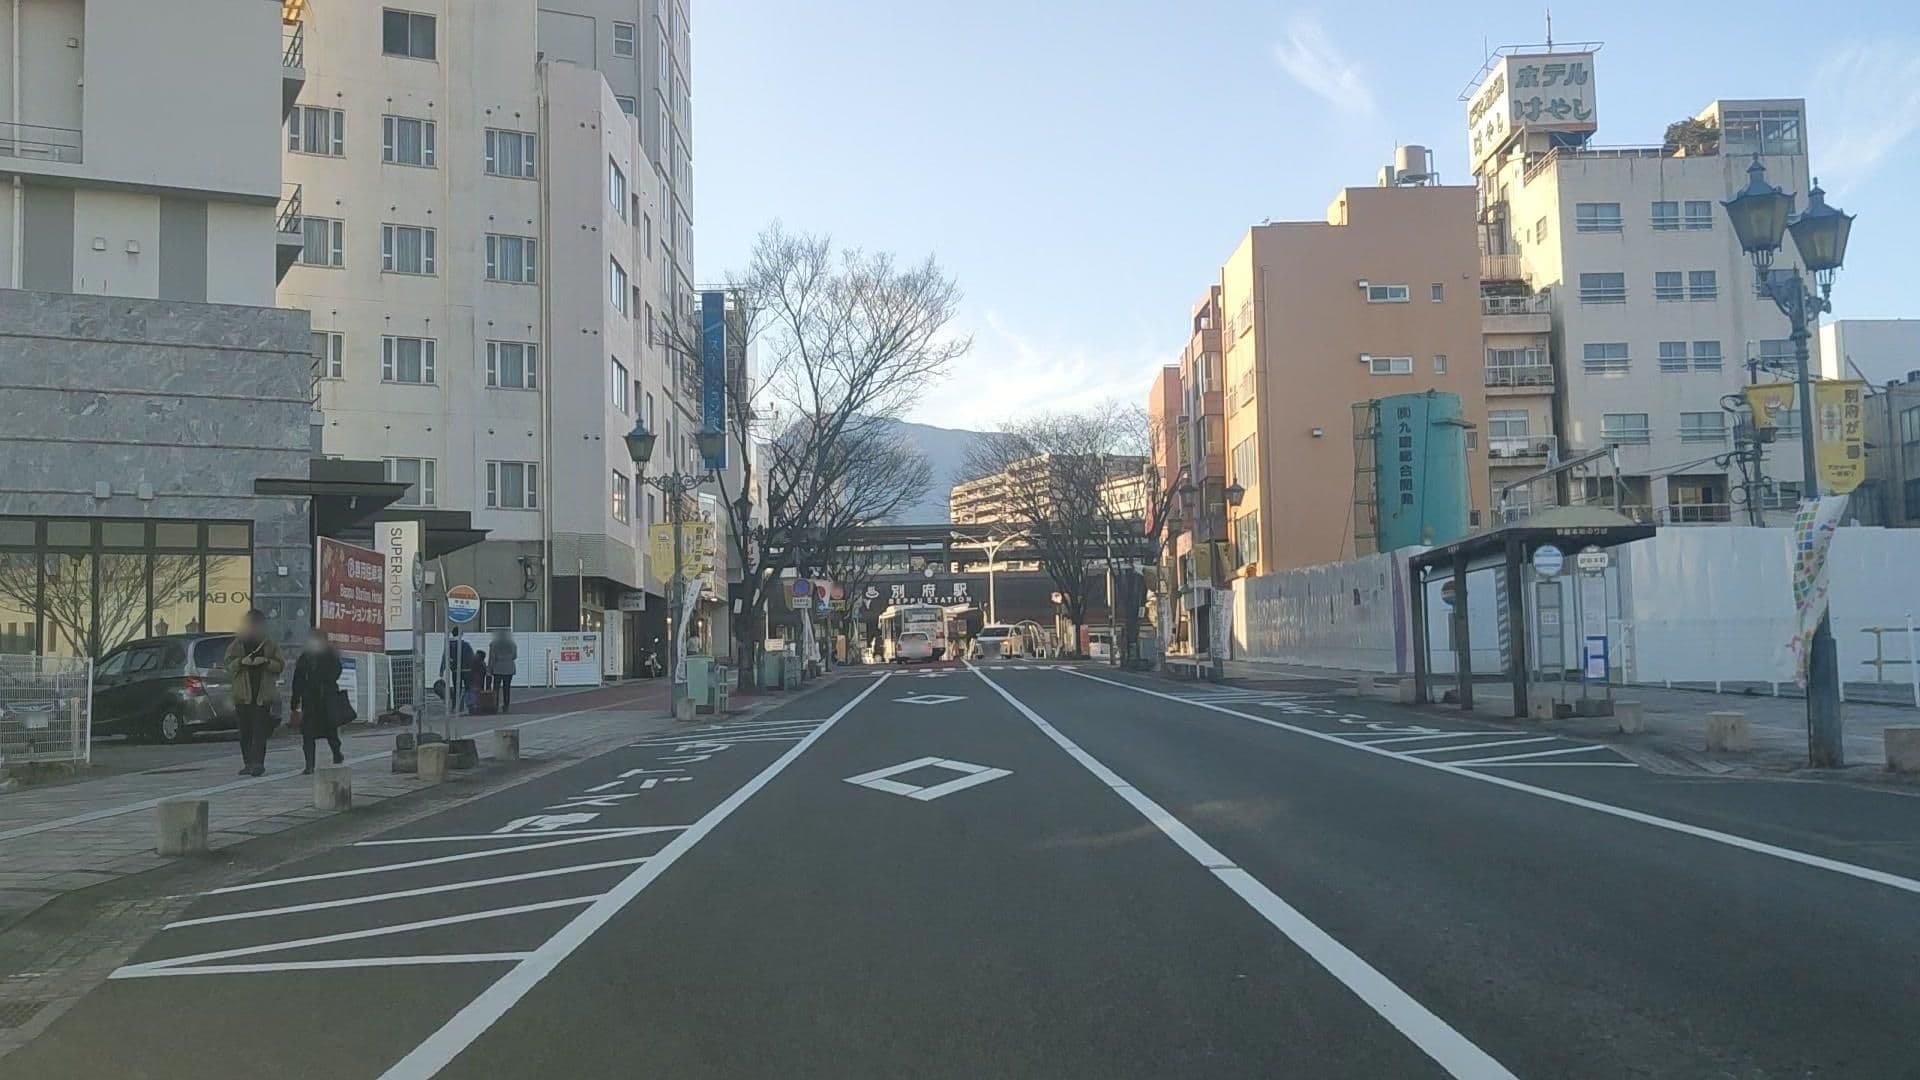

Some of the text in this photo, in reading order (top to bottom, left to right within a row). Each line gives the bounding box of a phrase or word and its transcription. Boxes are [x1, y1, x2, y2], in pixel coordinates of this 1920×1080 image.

[1516, 63, 1588, 88] ホテル
[1514, 96, 1592, 121] はやし
[891, 583, 968, 598] 別府駅
[927, 596, 972, 604] STATION
